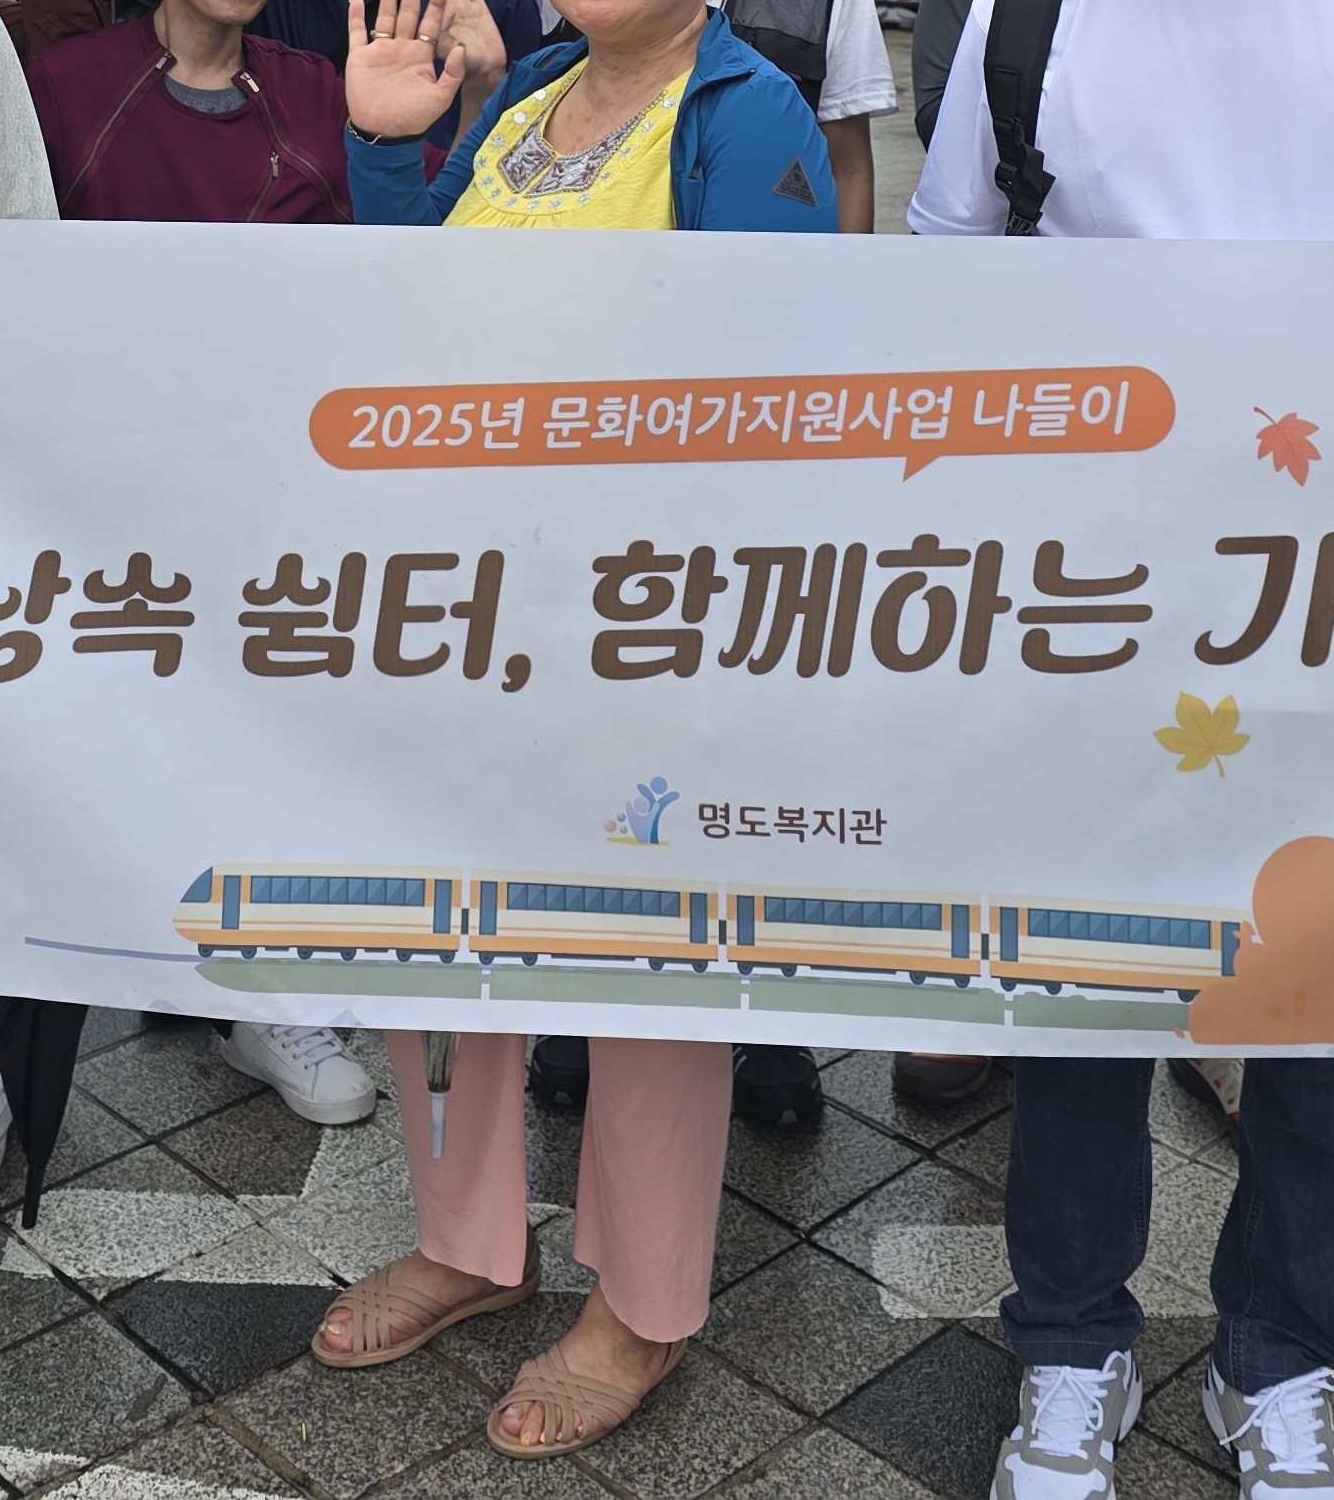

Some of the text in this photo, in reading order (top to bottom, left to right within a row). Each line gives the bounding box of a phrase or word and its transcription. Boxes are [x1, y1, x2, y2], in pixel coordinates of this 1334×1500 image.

[347, 380, 1131, 450] 2025년 문화여가지원사업 나들이
[238, 549, 533, 694] 쉼터,
[589, 533, 1154, 681] 함께하는
[696, 801, 889, 846] 명도복지관
